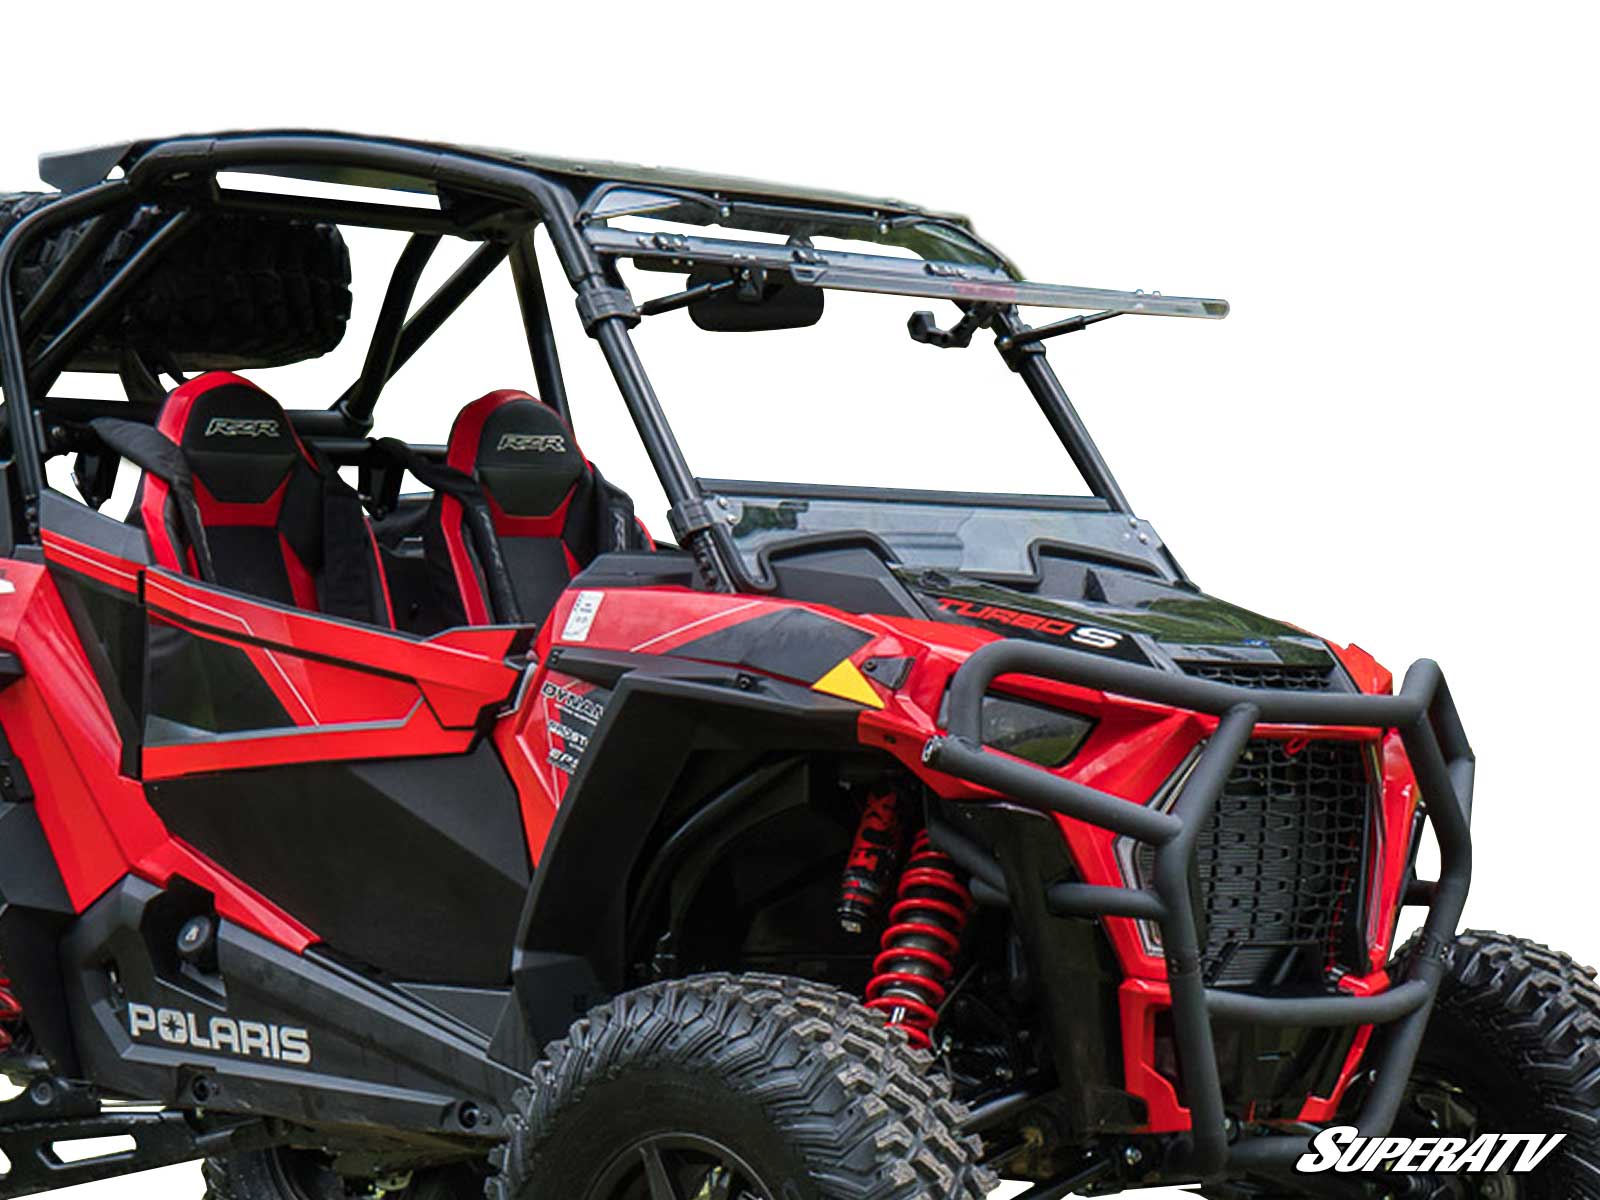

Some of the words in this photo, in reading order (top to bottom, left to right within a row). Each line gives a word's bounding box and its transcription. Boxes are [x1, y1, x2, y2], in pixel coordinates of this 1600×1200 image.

[204, 417, 280, 437] RZR
[496, 433, 567, 452] RZR
[937, 597, 1077, 636] TURBO
[1070, 626, 1123, 649] S
[847, 790, 898, 872] FOX
[128, 1002, 311, 1063] POLARIS
